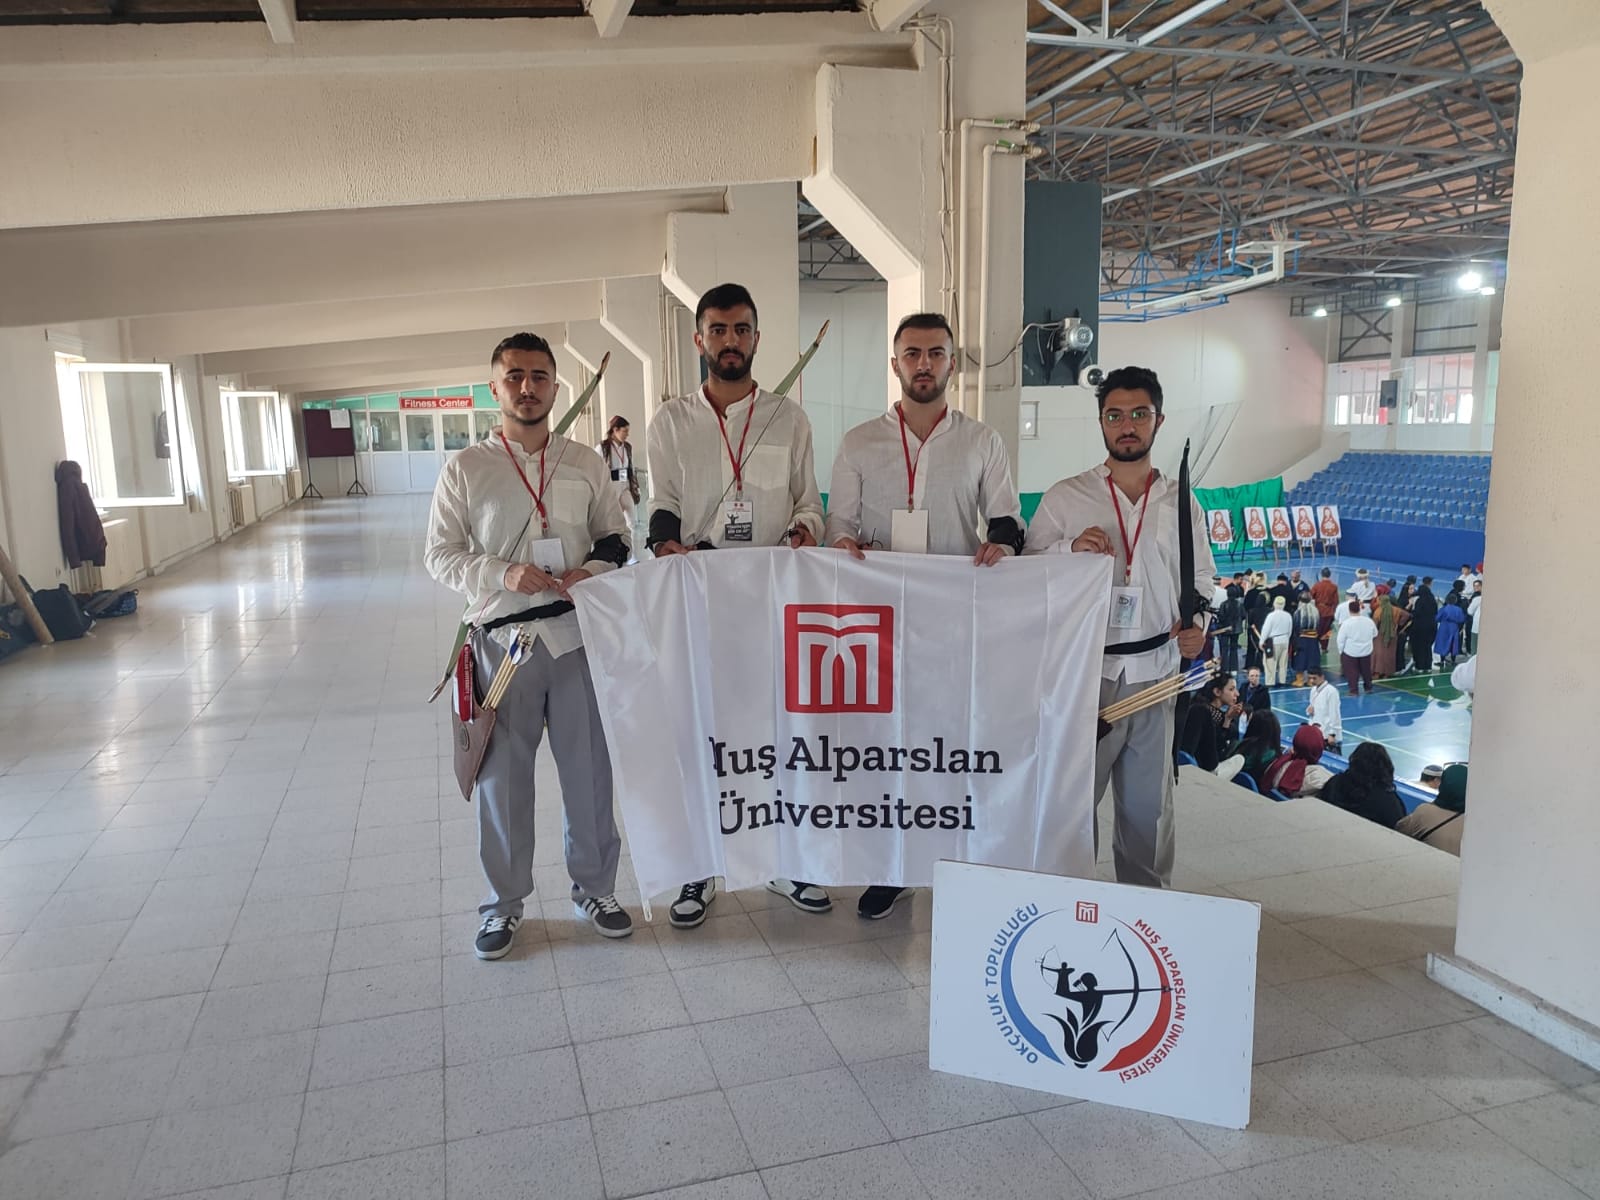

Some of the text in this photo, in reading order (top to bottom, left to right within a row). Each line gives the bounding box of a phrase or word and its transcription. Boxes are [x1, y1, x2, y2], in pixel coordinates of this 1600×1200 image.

[404, 398, 469, 408] Fitness Center
[785, 735, 1003, 782] Alparslan
[719, 790, 976, 835] Üniversitesi
[985, 903, 1040, 1064] OKÇULUK TOPLULUĞU
[1119, 919, 1187, 1084] MUŞ ALPARSLAN ÜNİVERSİTESİ
